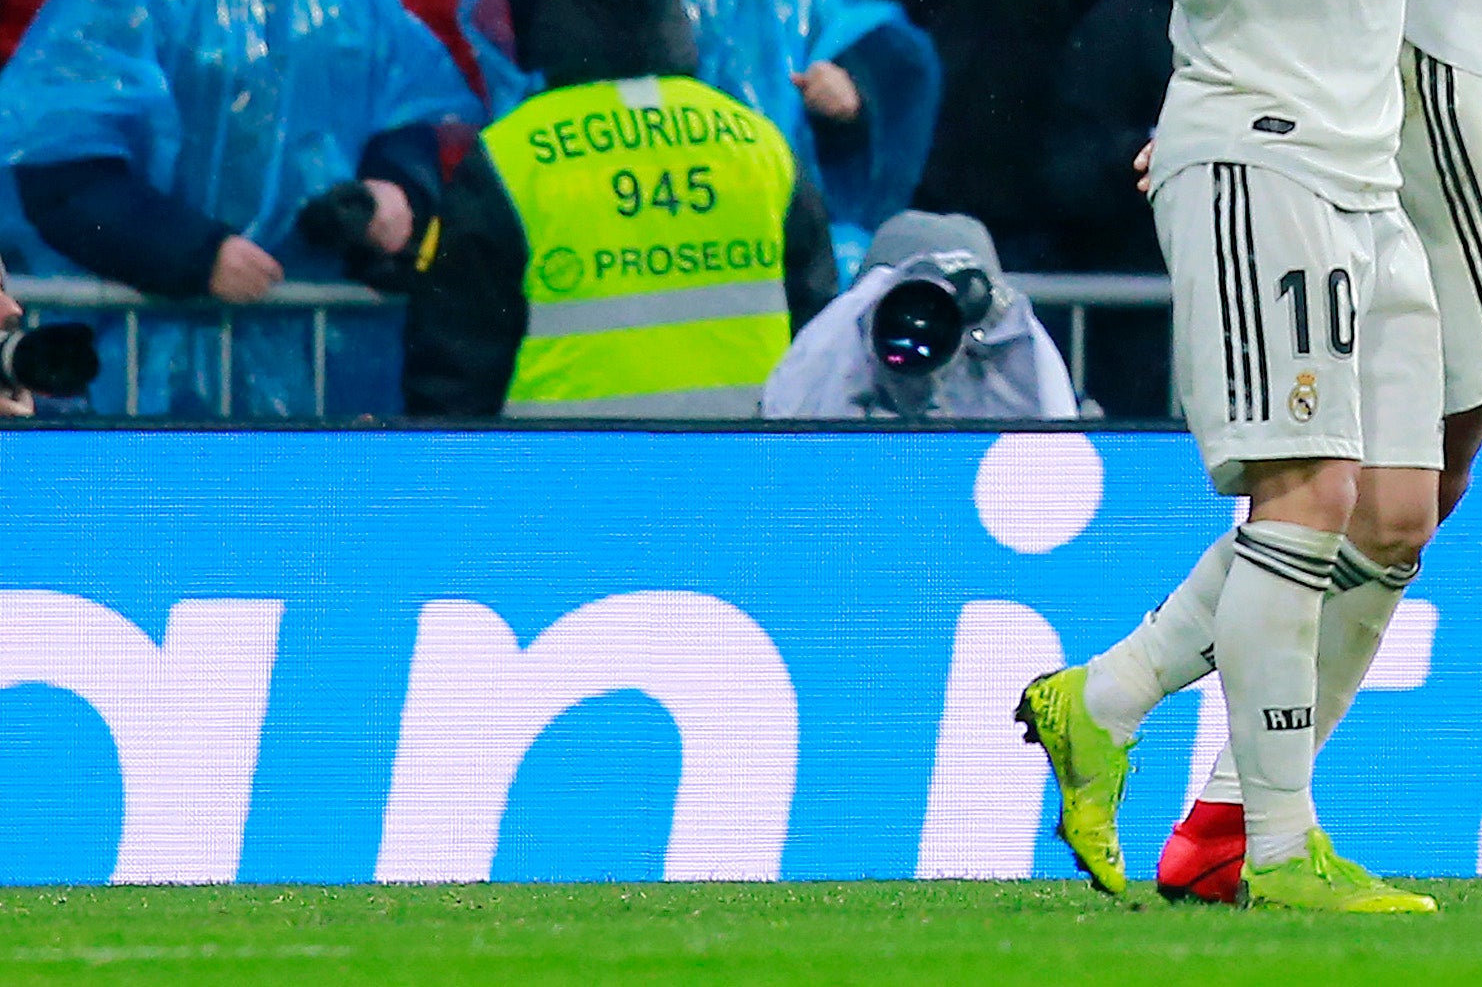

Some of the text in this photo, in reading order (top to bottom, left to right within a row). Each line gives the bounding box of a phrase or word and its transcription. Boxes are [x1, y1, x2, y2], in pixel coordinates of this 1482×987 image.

[528, 106, 757, 164] SEGURIDAD
[611, 165, 717, 218] 945
[594, 239, 777, 279] PROSEGU
[1274, 266, 1357, 358] 10
